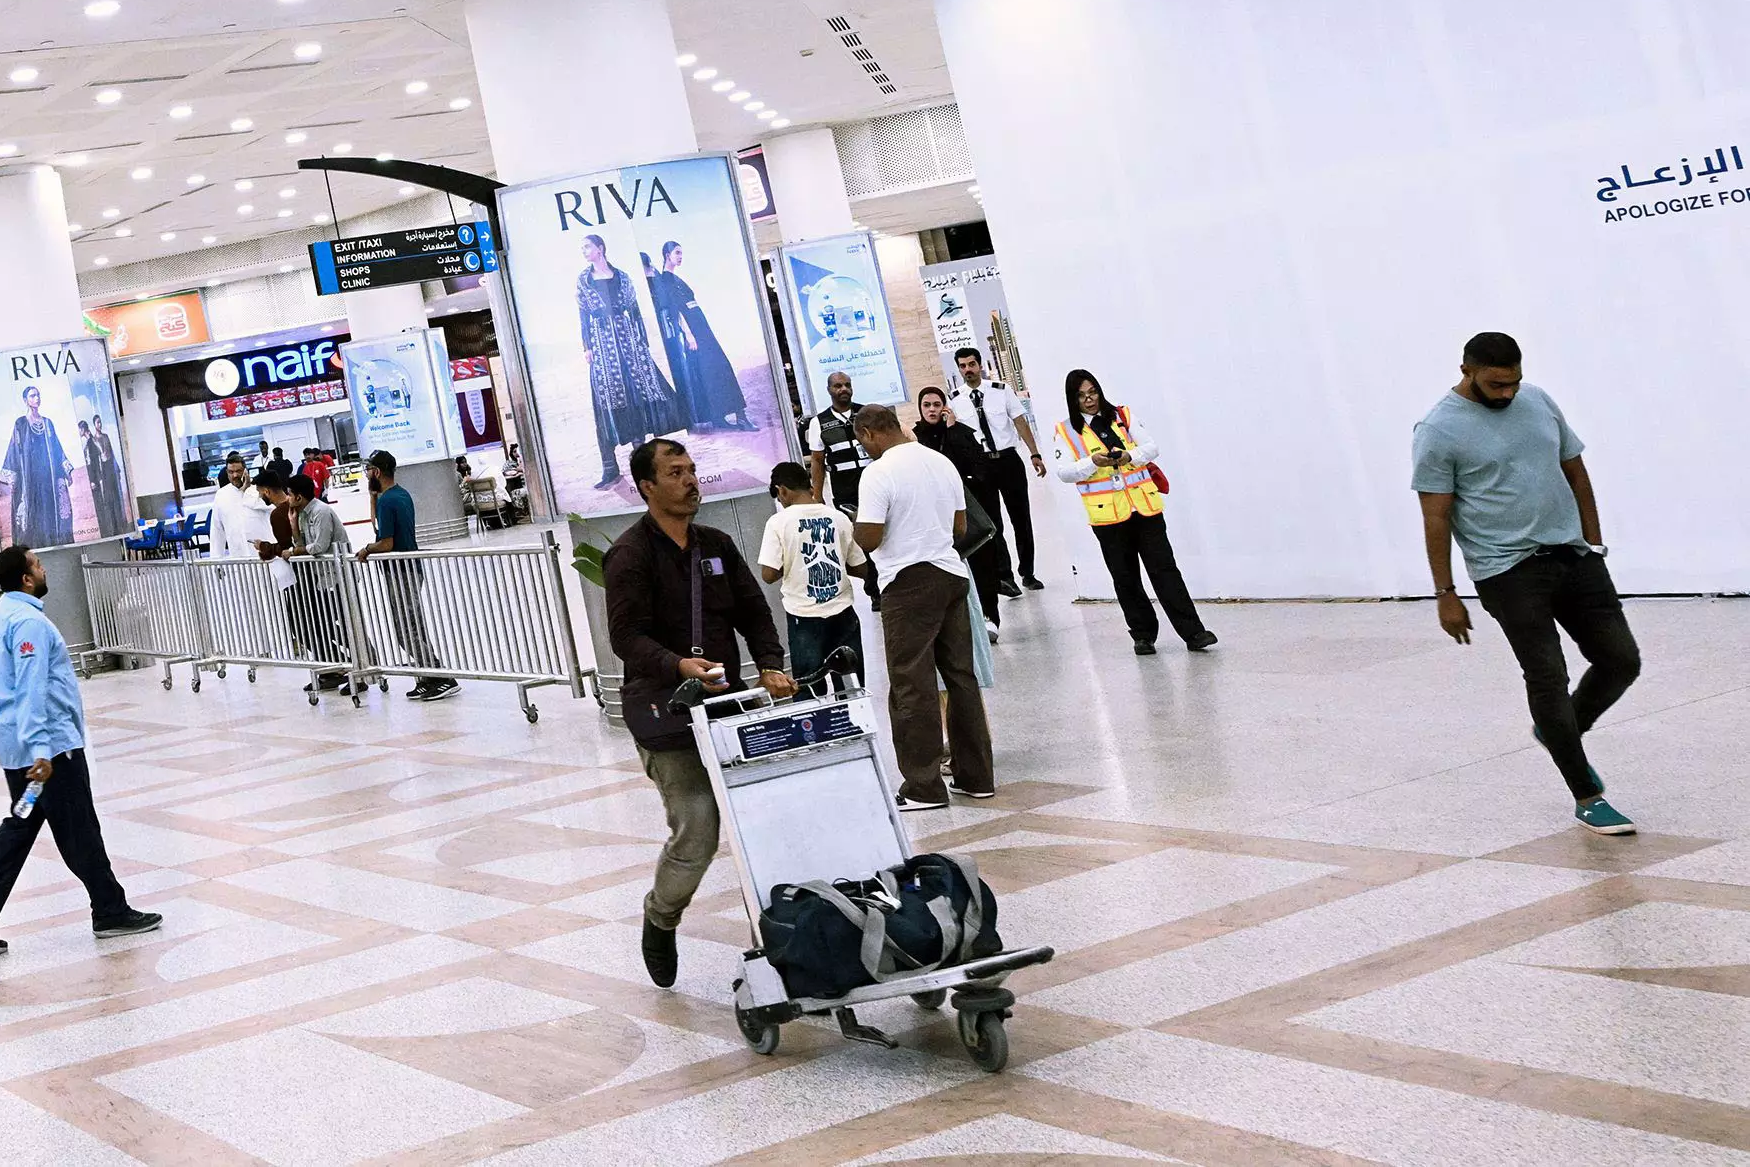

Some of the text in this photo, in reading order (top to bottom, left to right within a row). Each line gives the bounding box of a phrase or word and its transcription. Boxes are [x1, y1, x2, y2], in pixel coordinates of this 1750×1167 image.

[1596, 145, 1744, 202] الإزعاج
[554, 176, 679, 231] RIVA
[1605, 194, 1714, 223] APOLOGIZE
[335, 241, 356, 253] EXIT
[337, 249, 396, 264] INFORMATION
[437, 255, 460, 265] محلات
[340, 266, 371, 278] SHOPS
[341, 278, 371, 289] CLINIC
[11, 349, 81, 381] RIVA
[244, 341, 335, 386] naif
[370, 420, 411, 432] Welcome Back
[798, 517, 833, 533] JUMP
